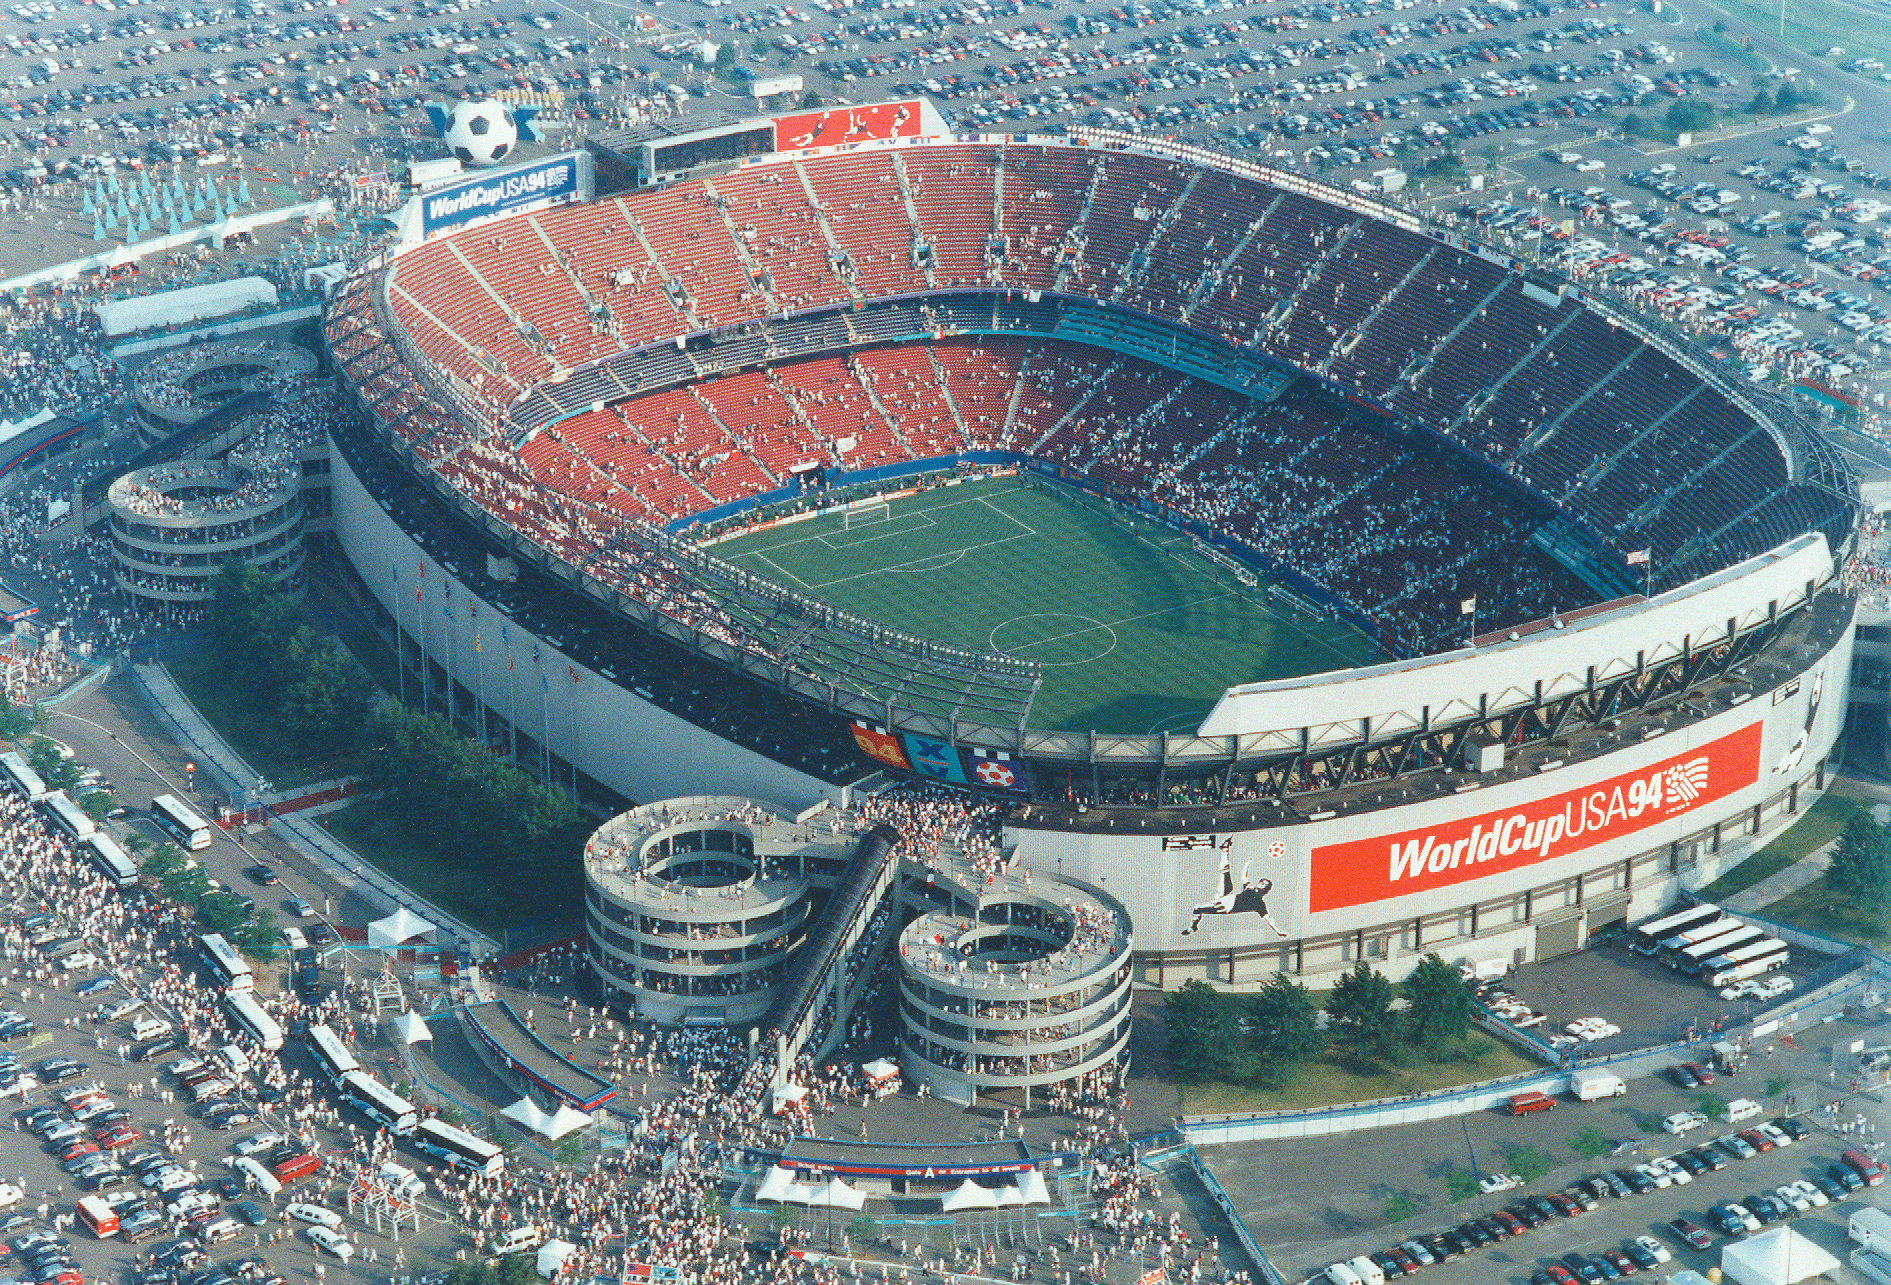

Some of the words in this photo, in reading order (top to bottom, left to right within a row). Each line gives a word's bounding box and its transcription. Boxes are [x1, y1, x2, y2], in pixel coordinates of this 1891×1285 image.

[430, 171, 546, 219] WorldCupUSA94
[854, 734, 902, 763] 94
[1389, 771, 1663, 882] WorldCupUSA94
[924, 1167, 935, 1179] A
